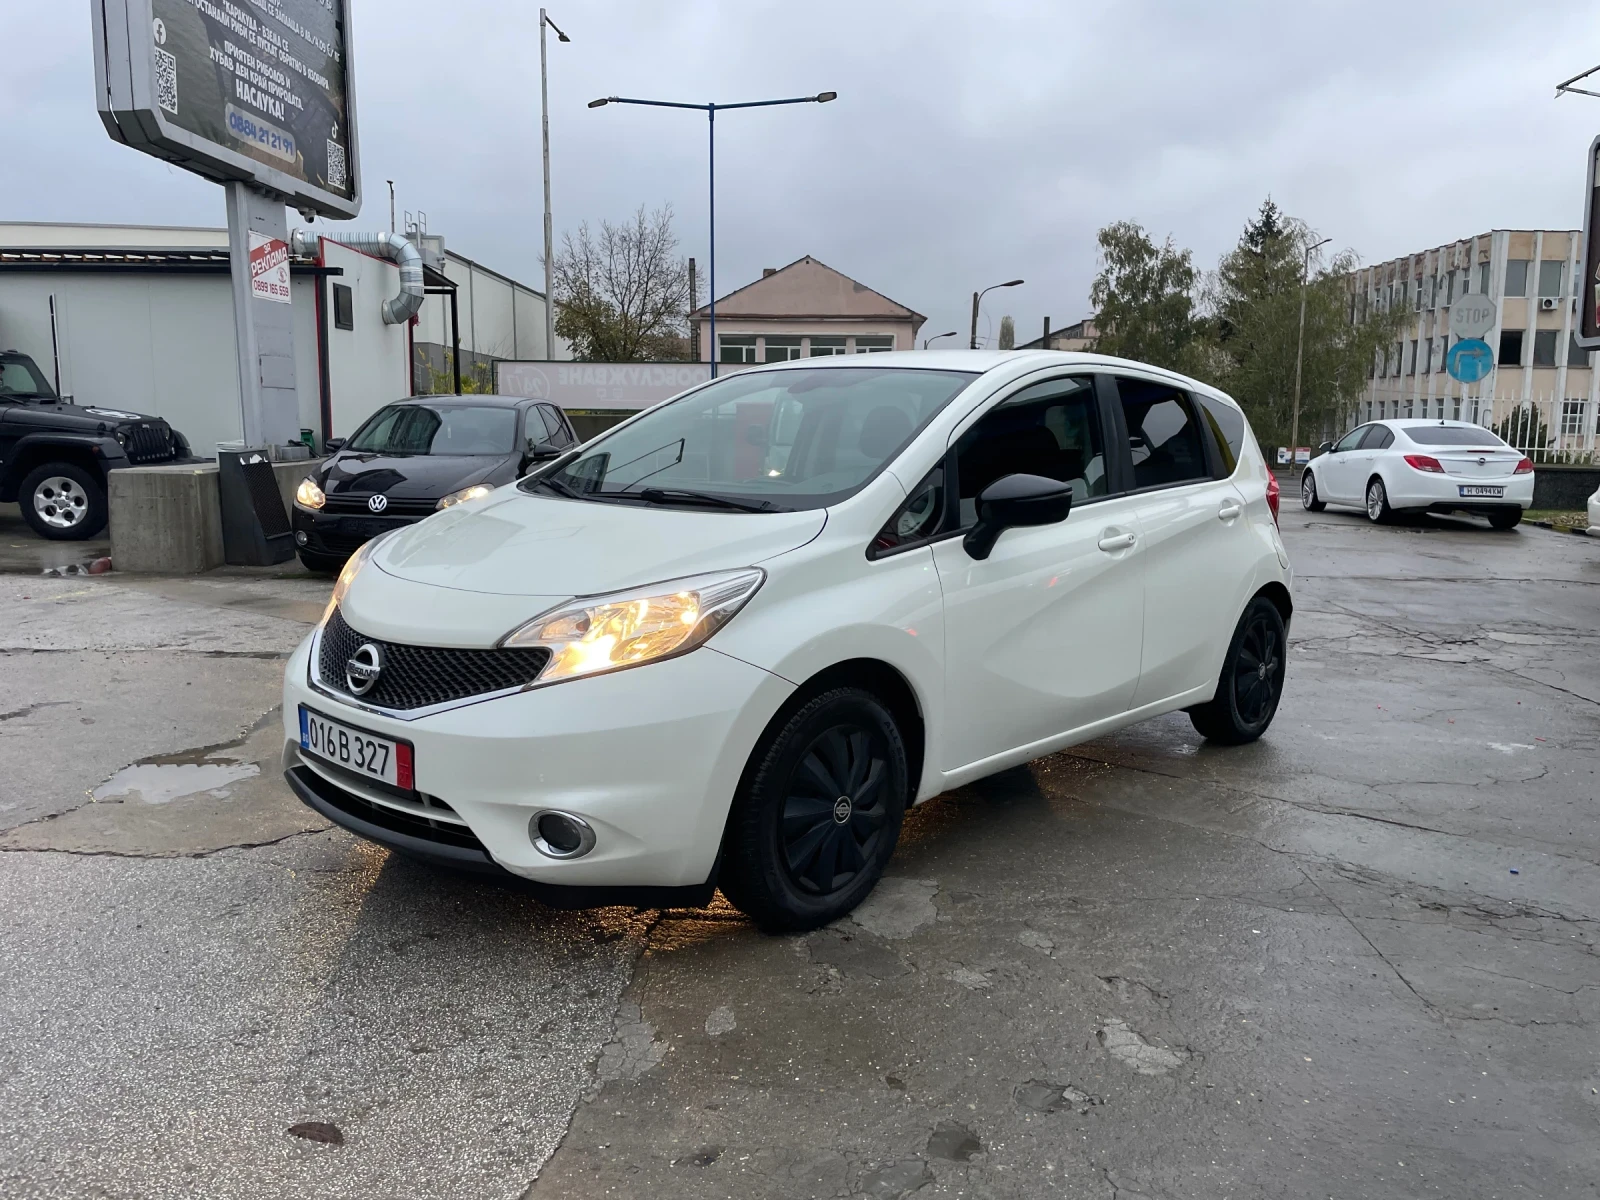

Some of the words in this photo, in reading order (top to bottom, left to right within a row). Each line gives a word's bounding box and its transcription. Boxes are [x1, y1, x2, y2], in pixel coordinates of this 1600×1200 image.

[230, 17, 248, 39] РИБИ
[248, 30, 256, 44] СЕ
[282, 38, 289, 52] СЕ
[209, 46, 234, 71] ХУБАВ
[235, 62, 249, 80] ДЕН
[250, 70, 267, 91] КРАЙ
[224, 40, 255, 69] ПРИЯТЕН
[256, 59, 285, 86] РИБОЛОВ
[286, 76, 291, 89] И
[235, 78, 285, 121] НАСЛУКА!
[229, 112, 257, 139] 0884
[259, 127, 269, 145] 21
[271, 132, 281, 150] 21
[283, 138, 293, 156] 91
[250, 246, 288, 277] РЕКЛАМА
[263, 243, 272, 254] ЗА
[1456, 308, 1490, 324] STOP
